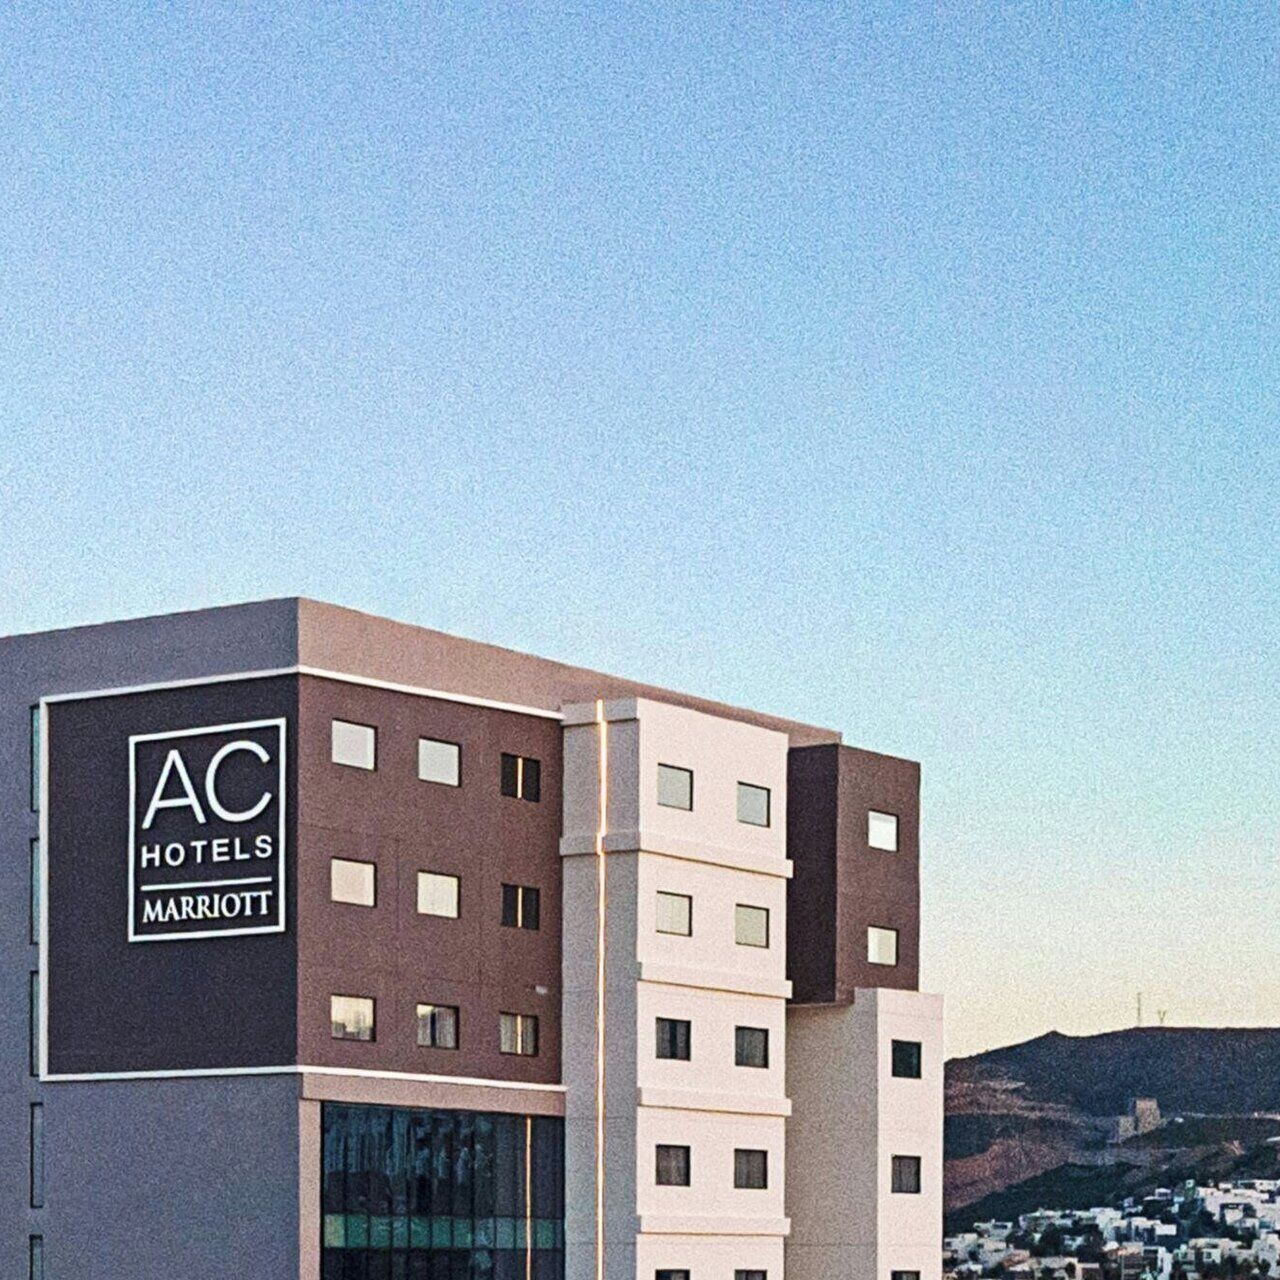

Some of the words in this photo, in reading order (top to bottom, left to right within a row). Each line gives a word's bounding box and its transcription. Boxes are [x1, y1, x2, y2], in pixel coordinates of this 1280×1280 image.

[141, 740, 272, 830] AC
[141, 835, 272, 868] HOTELS
[142, 890, 273, 923] MARRIOTT
